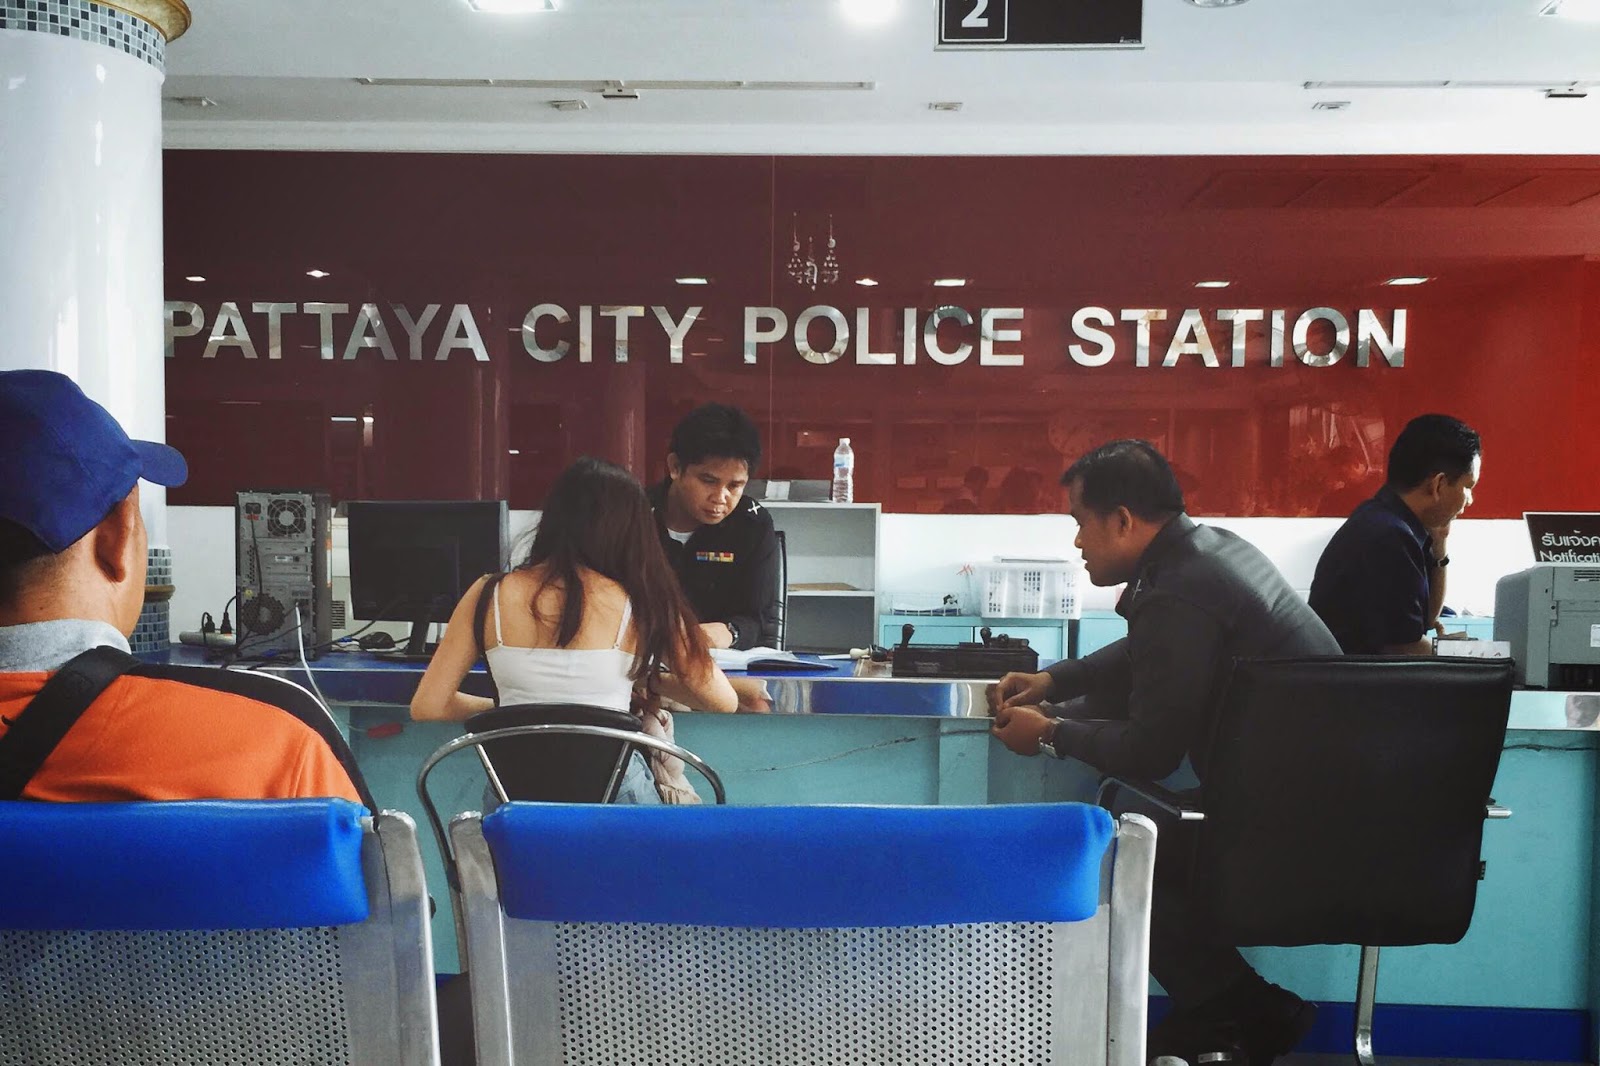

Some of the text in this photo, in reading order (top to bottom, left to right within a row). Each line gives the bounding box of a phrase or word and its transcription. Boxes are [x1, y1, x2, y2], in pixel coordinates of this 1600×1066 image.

[164, 300, 1409, 369] PATTAYA CITY POLICE STATION
